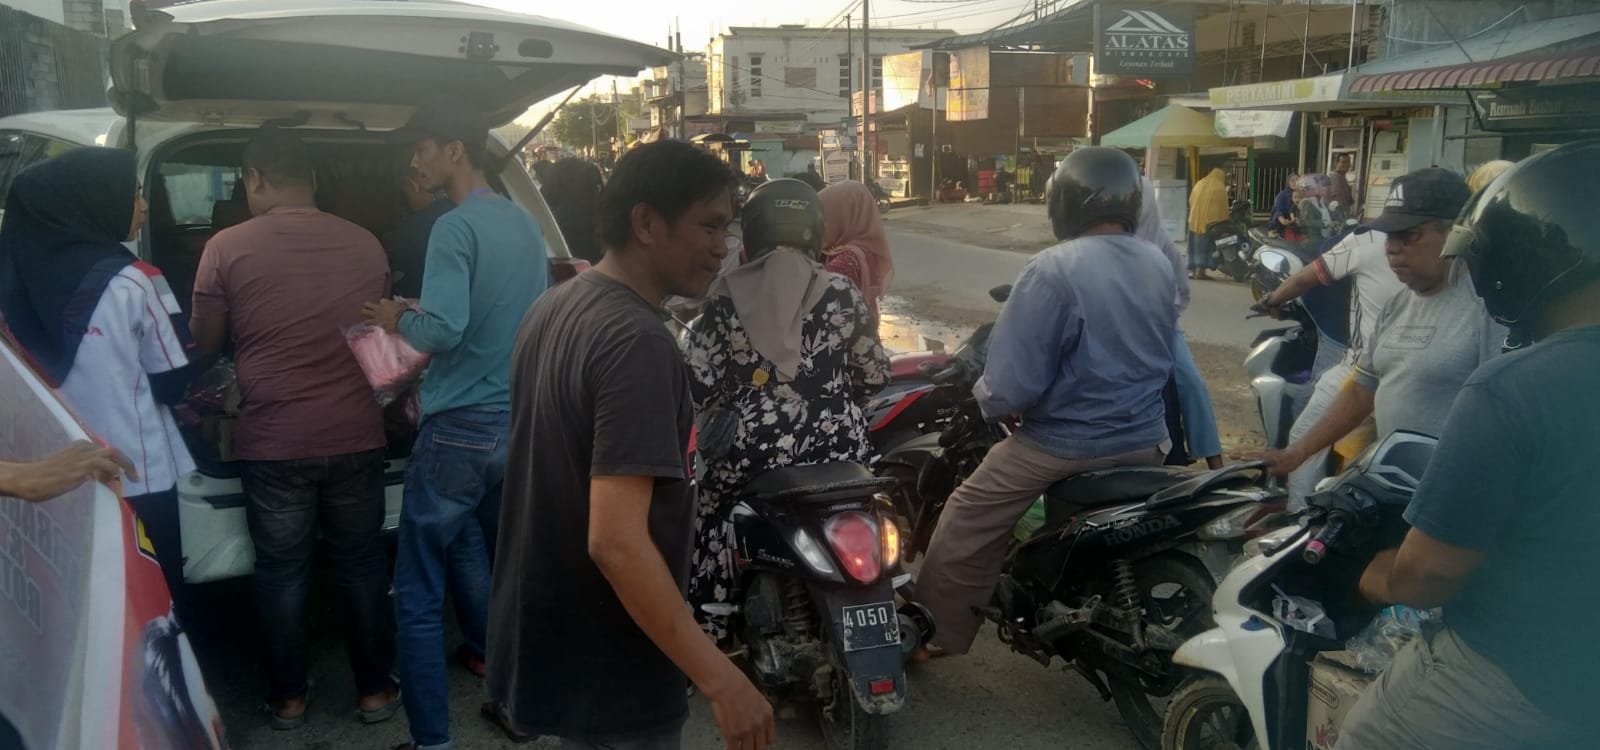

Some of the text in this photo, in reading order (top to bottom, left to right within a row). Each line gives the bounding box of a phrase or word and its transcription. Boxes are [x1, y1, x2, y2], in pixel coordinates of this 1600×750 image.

[1104, 35, 1189, 49] ALATAS
[1226, 83, 1296, 104] PERTAMINI
[1489, 99, 1527, 117] Rumah
[1104, 514, 1184, 547] HONDA
[844, 607, 889, 629] 4050
